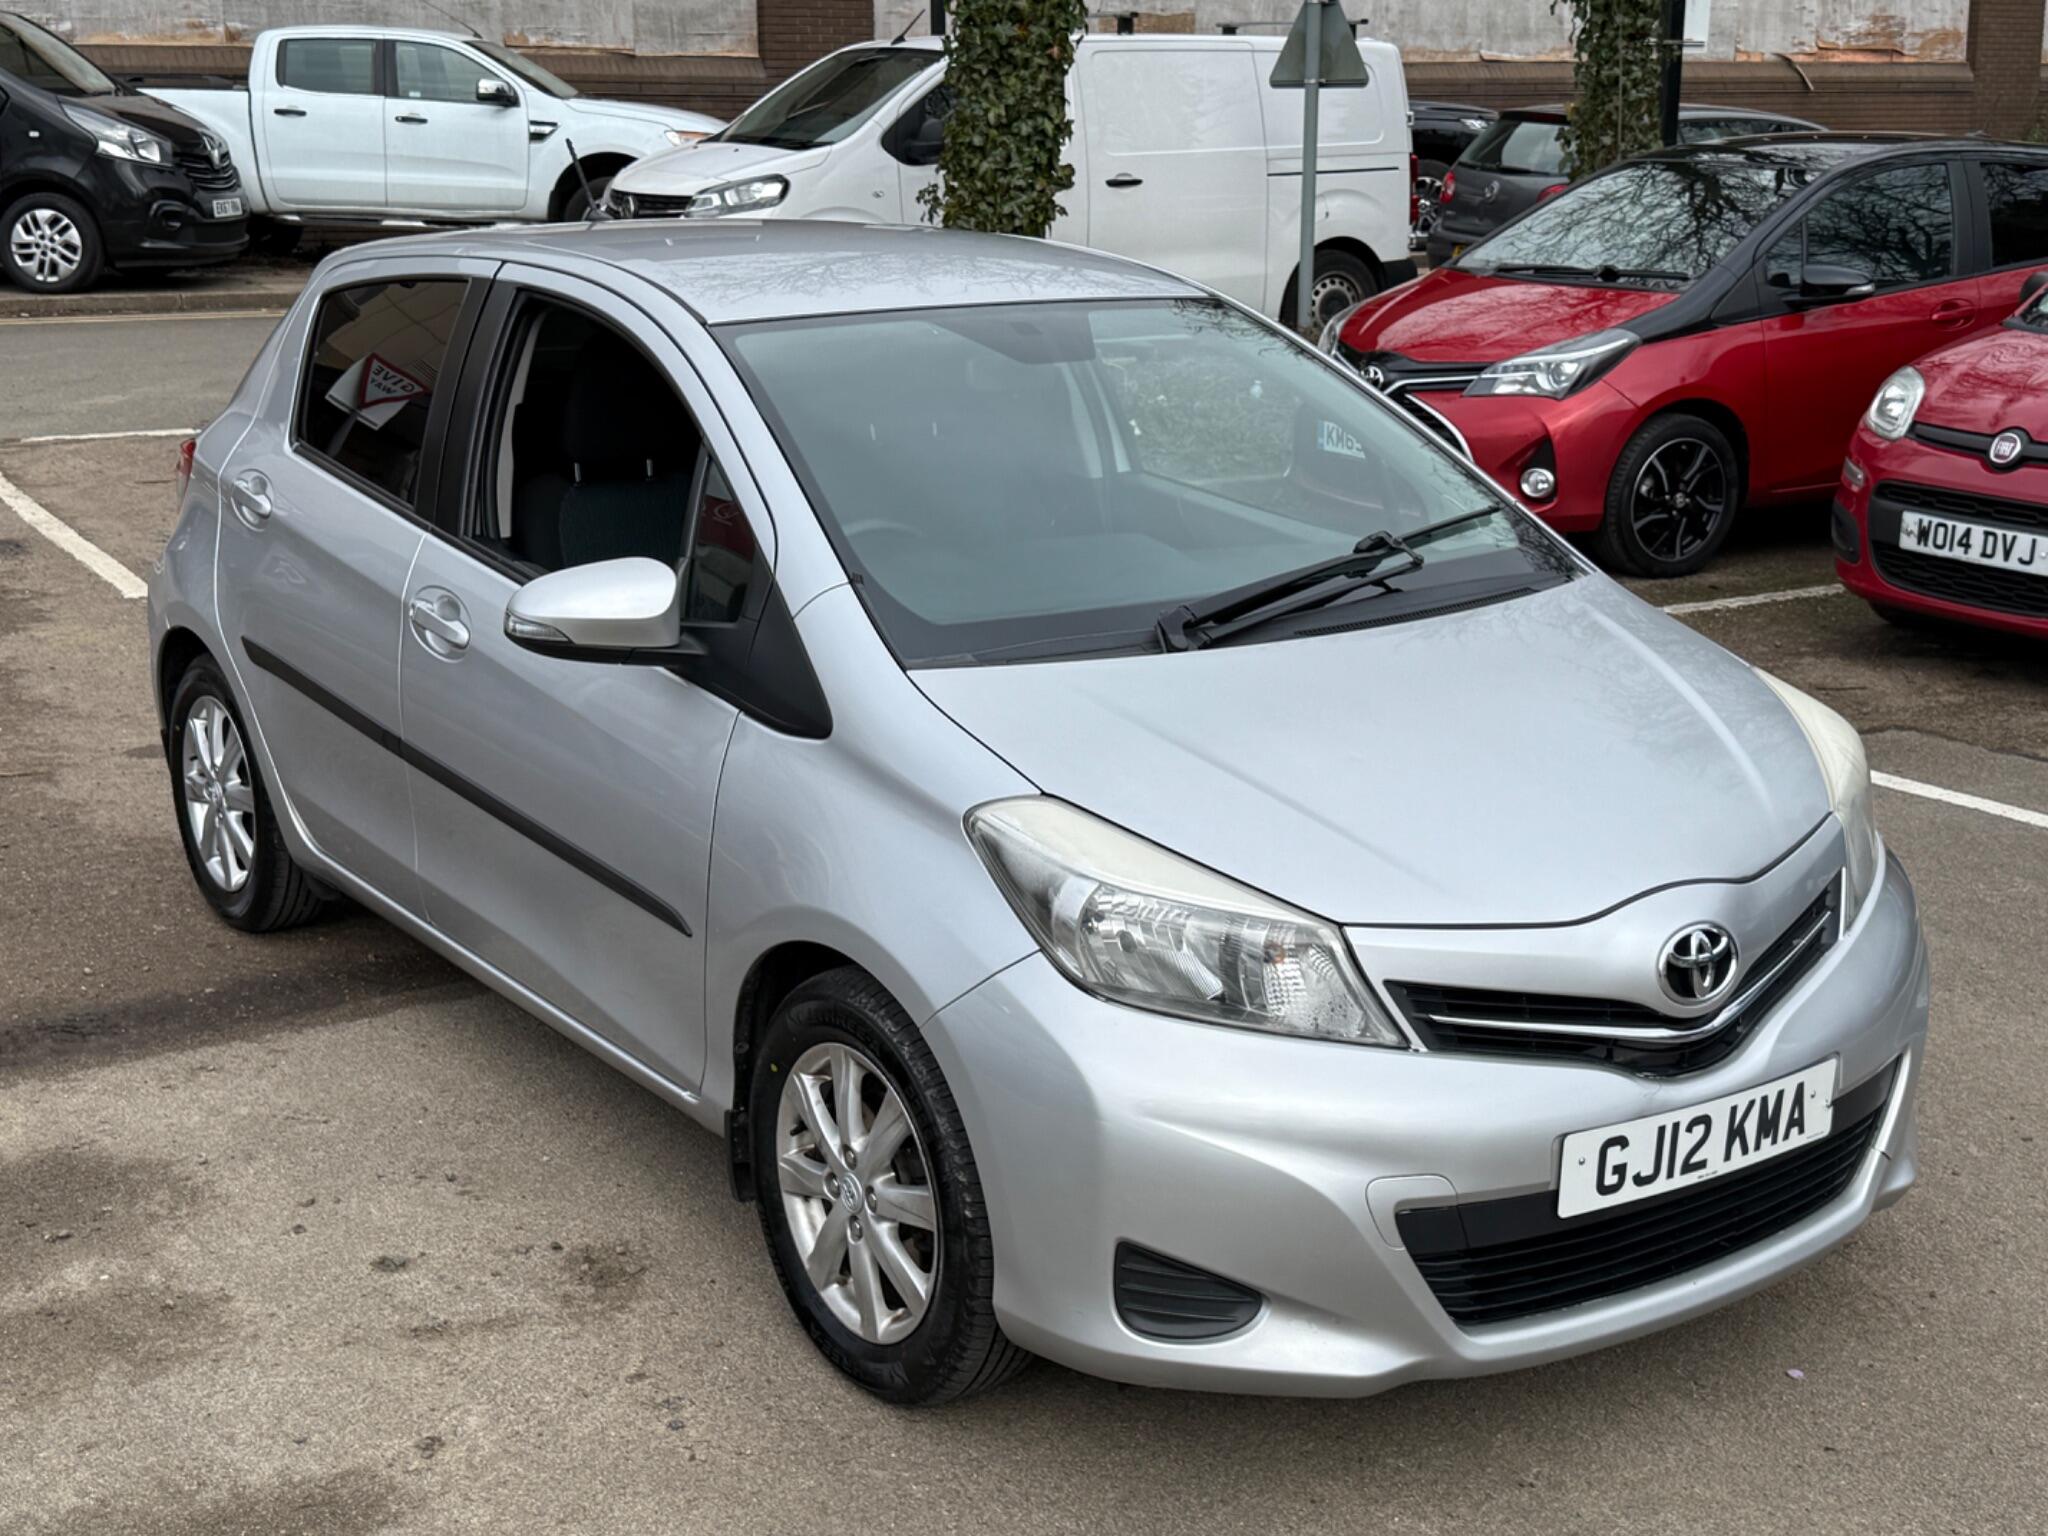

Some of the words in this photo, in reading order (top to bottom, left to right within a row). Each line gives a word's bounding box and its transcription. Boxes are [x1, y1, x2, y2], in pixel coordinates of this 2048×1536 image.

[1917, 518, 1972, 555] WO14
[1980, 530, 2037, 566] DVJ
[1595, 1113, 1713, 1197] GJ12
[1723, 1081, 1805, 1163] KMA
